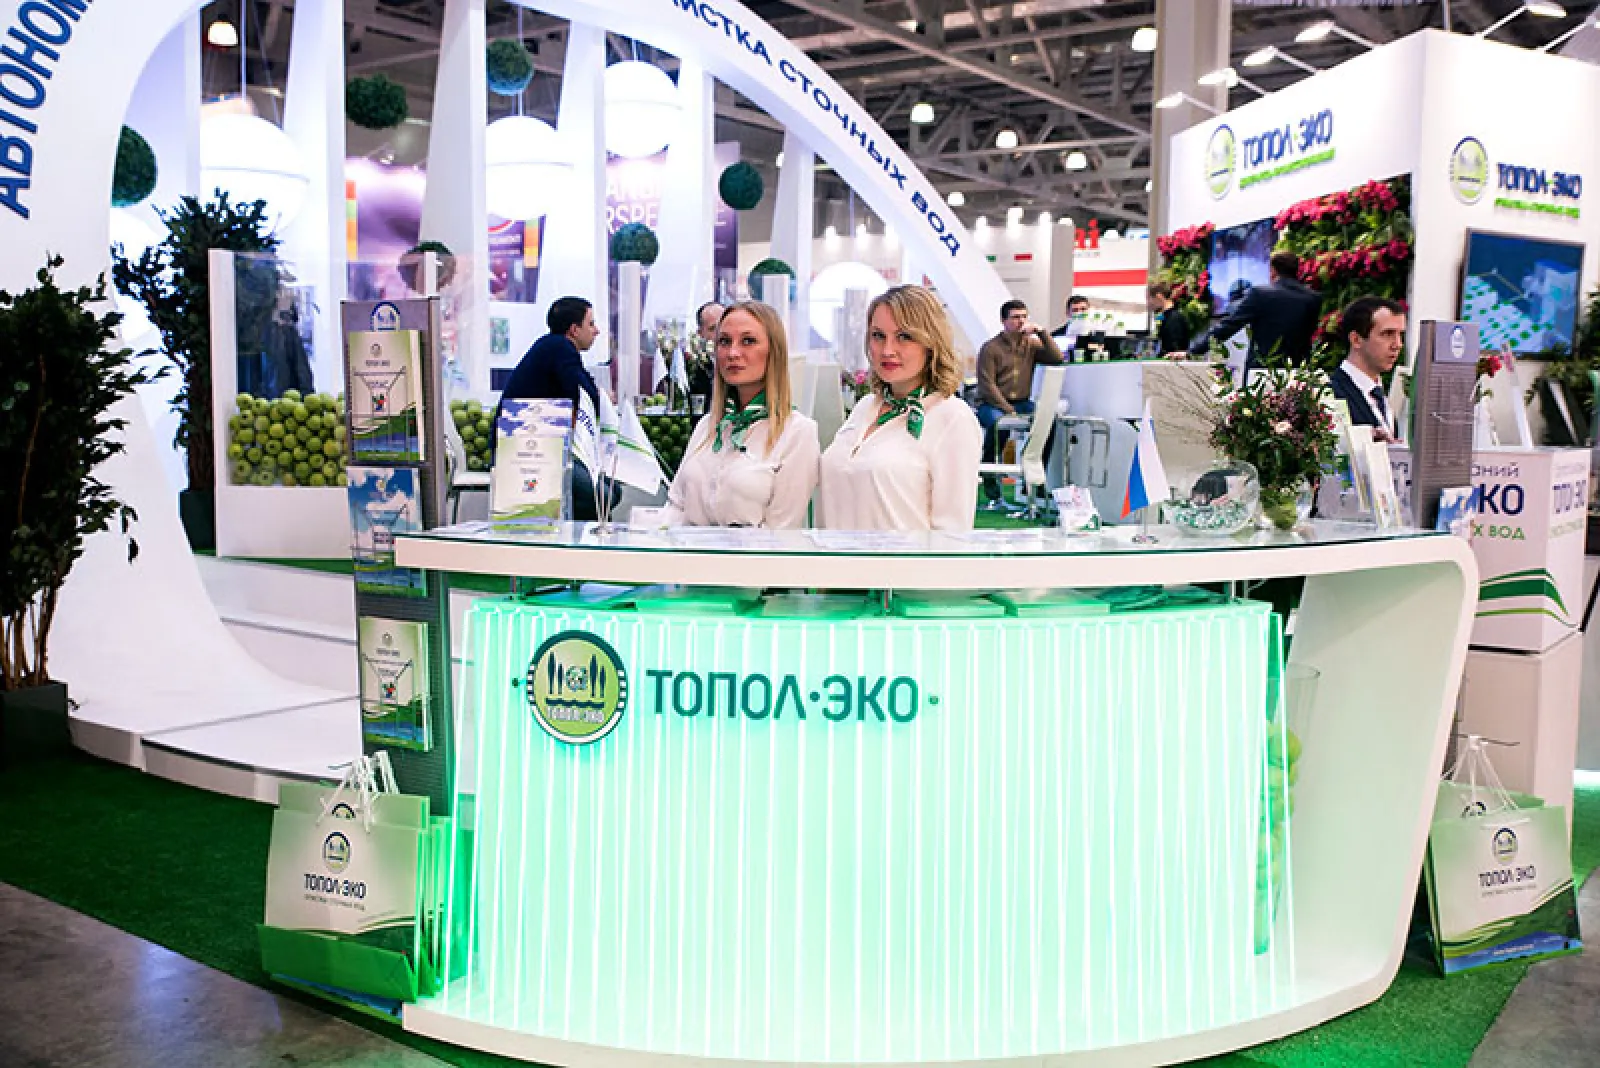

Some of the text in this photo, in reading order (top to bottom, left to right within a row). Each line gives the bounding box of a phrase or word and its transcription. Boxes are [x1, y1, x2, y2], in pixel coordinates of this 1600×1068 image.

[673, 0, 961, 257] ИСТКА СТОЧНЫХ ВОД
